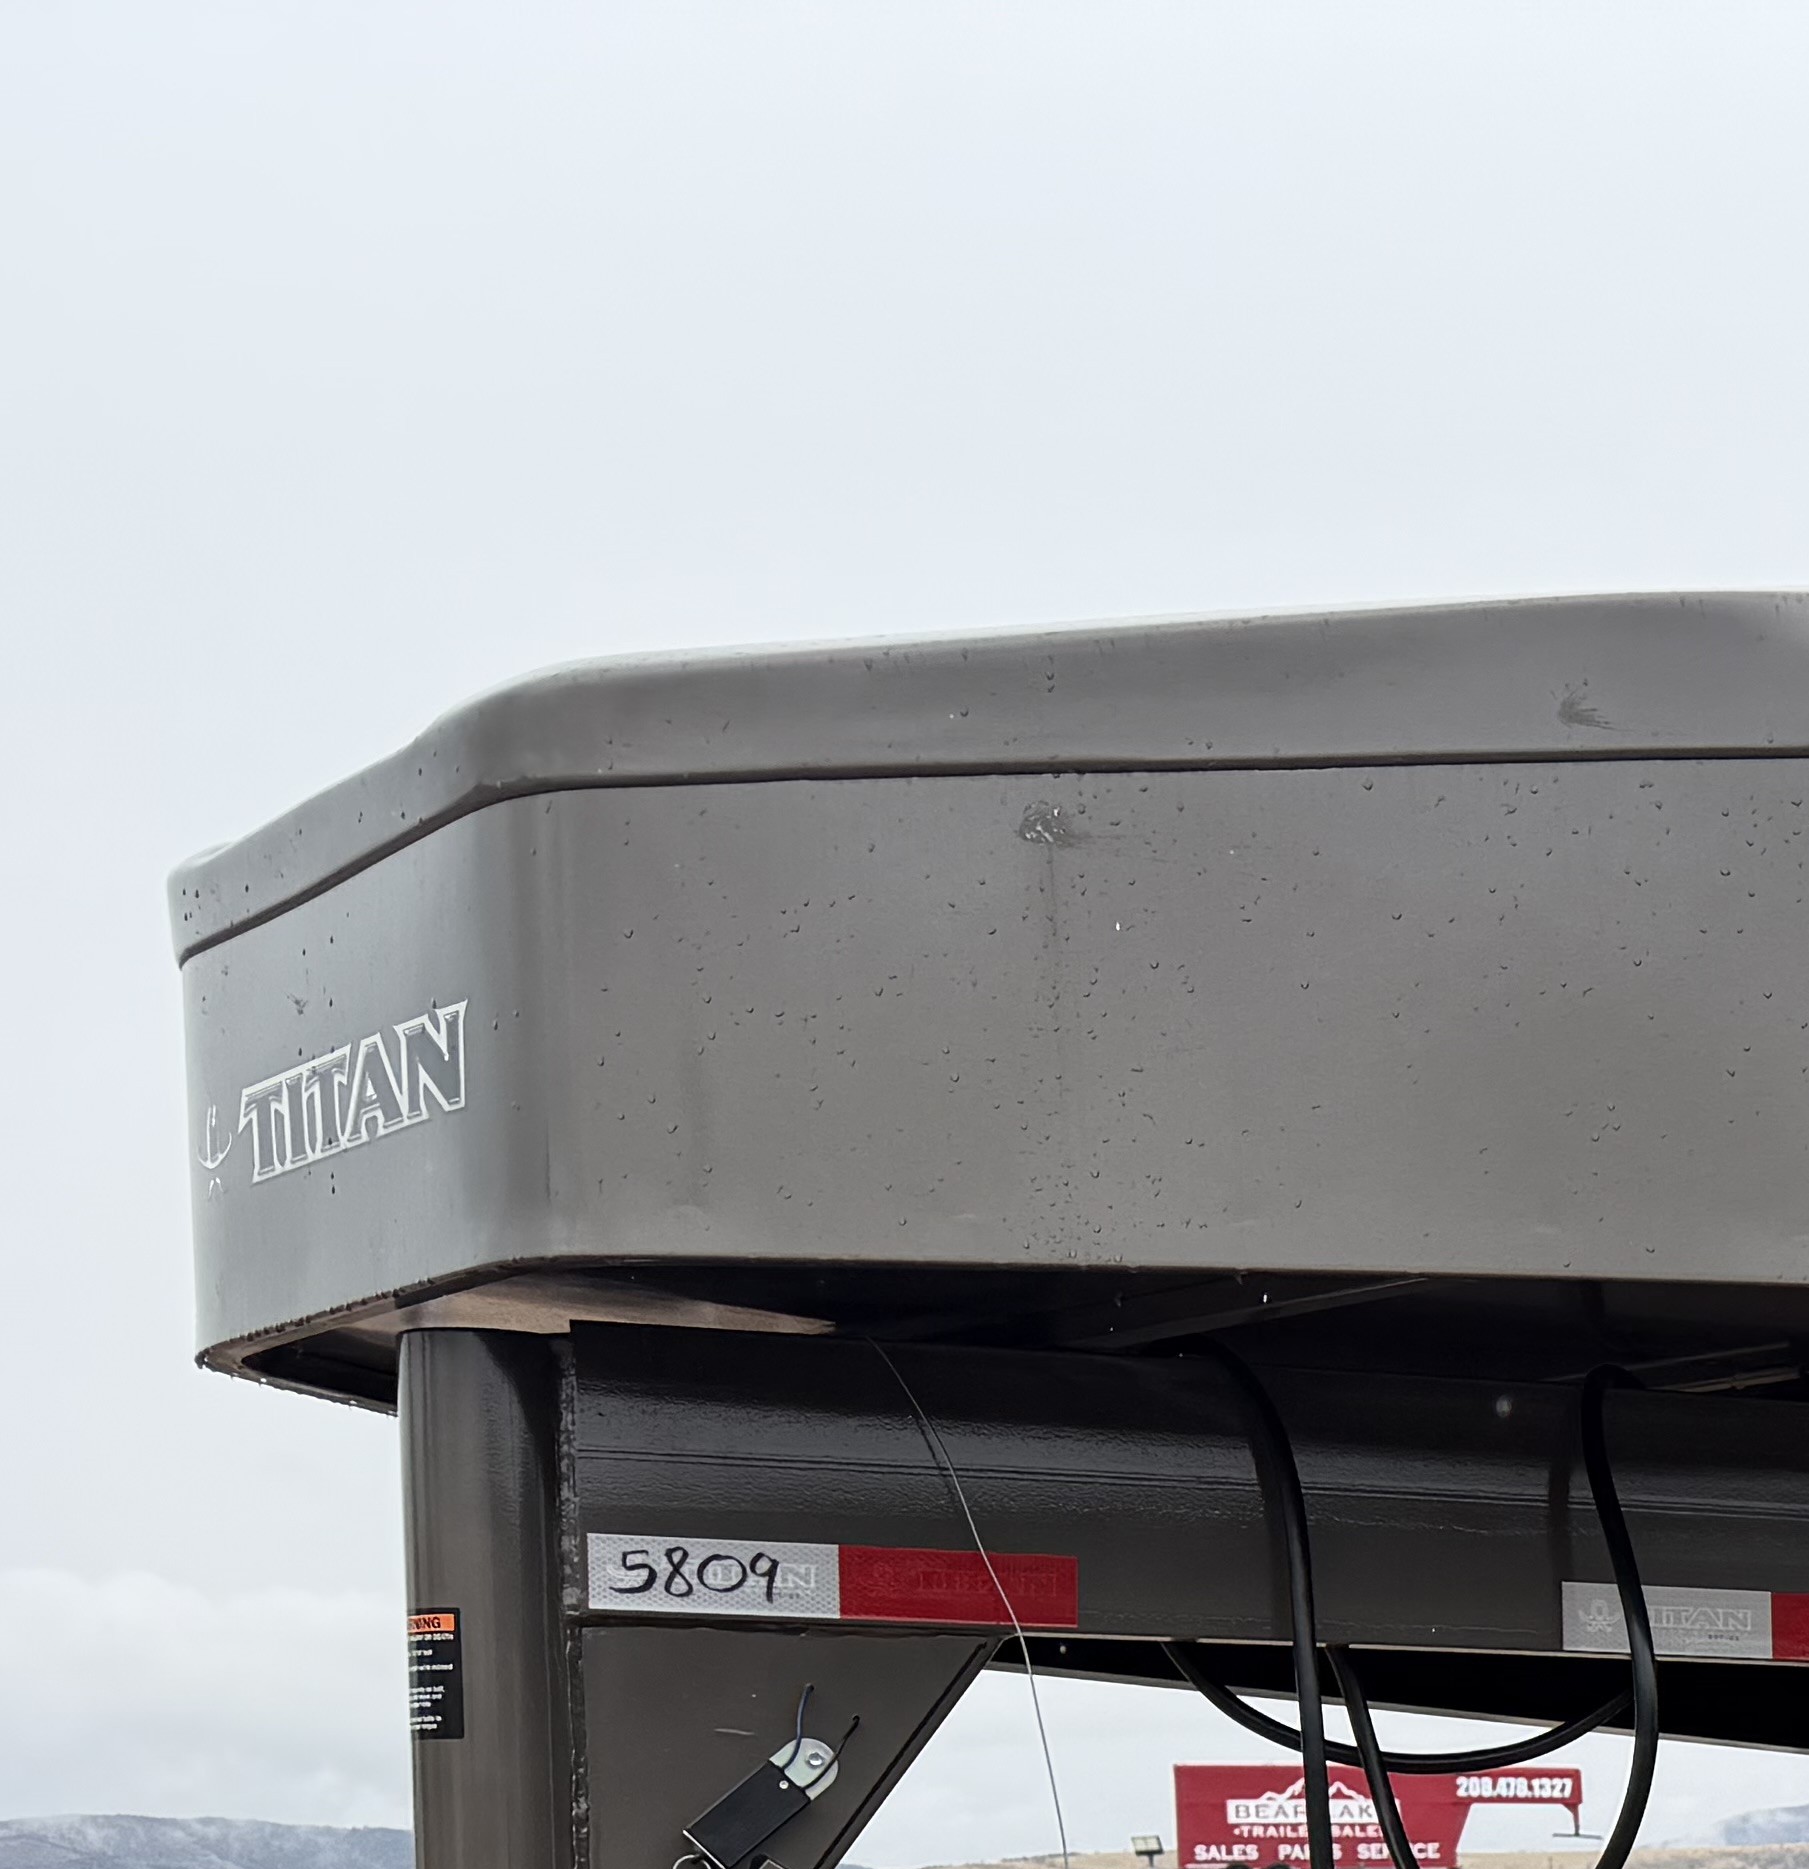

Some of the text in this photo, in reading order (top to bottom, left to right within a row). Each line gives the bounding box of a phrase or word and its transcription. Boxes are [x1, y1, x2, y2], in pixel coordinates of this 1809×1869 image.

[238, 999, 468, 1184] TITAN
[609, 1546, 780, 1604] 5809
[1648, 1606, 1752, 1631] ITAN
[1241, 1825, 1308, 1838] TRAILE
[1193, 1843, 1260, 1862] SALES
